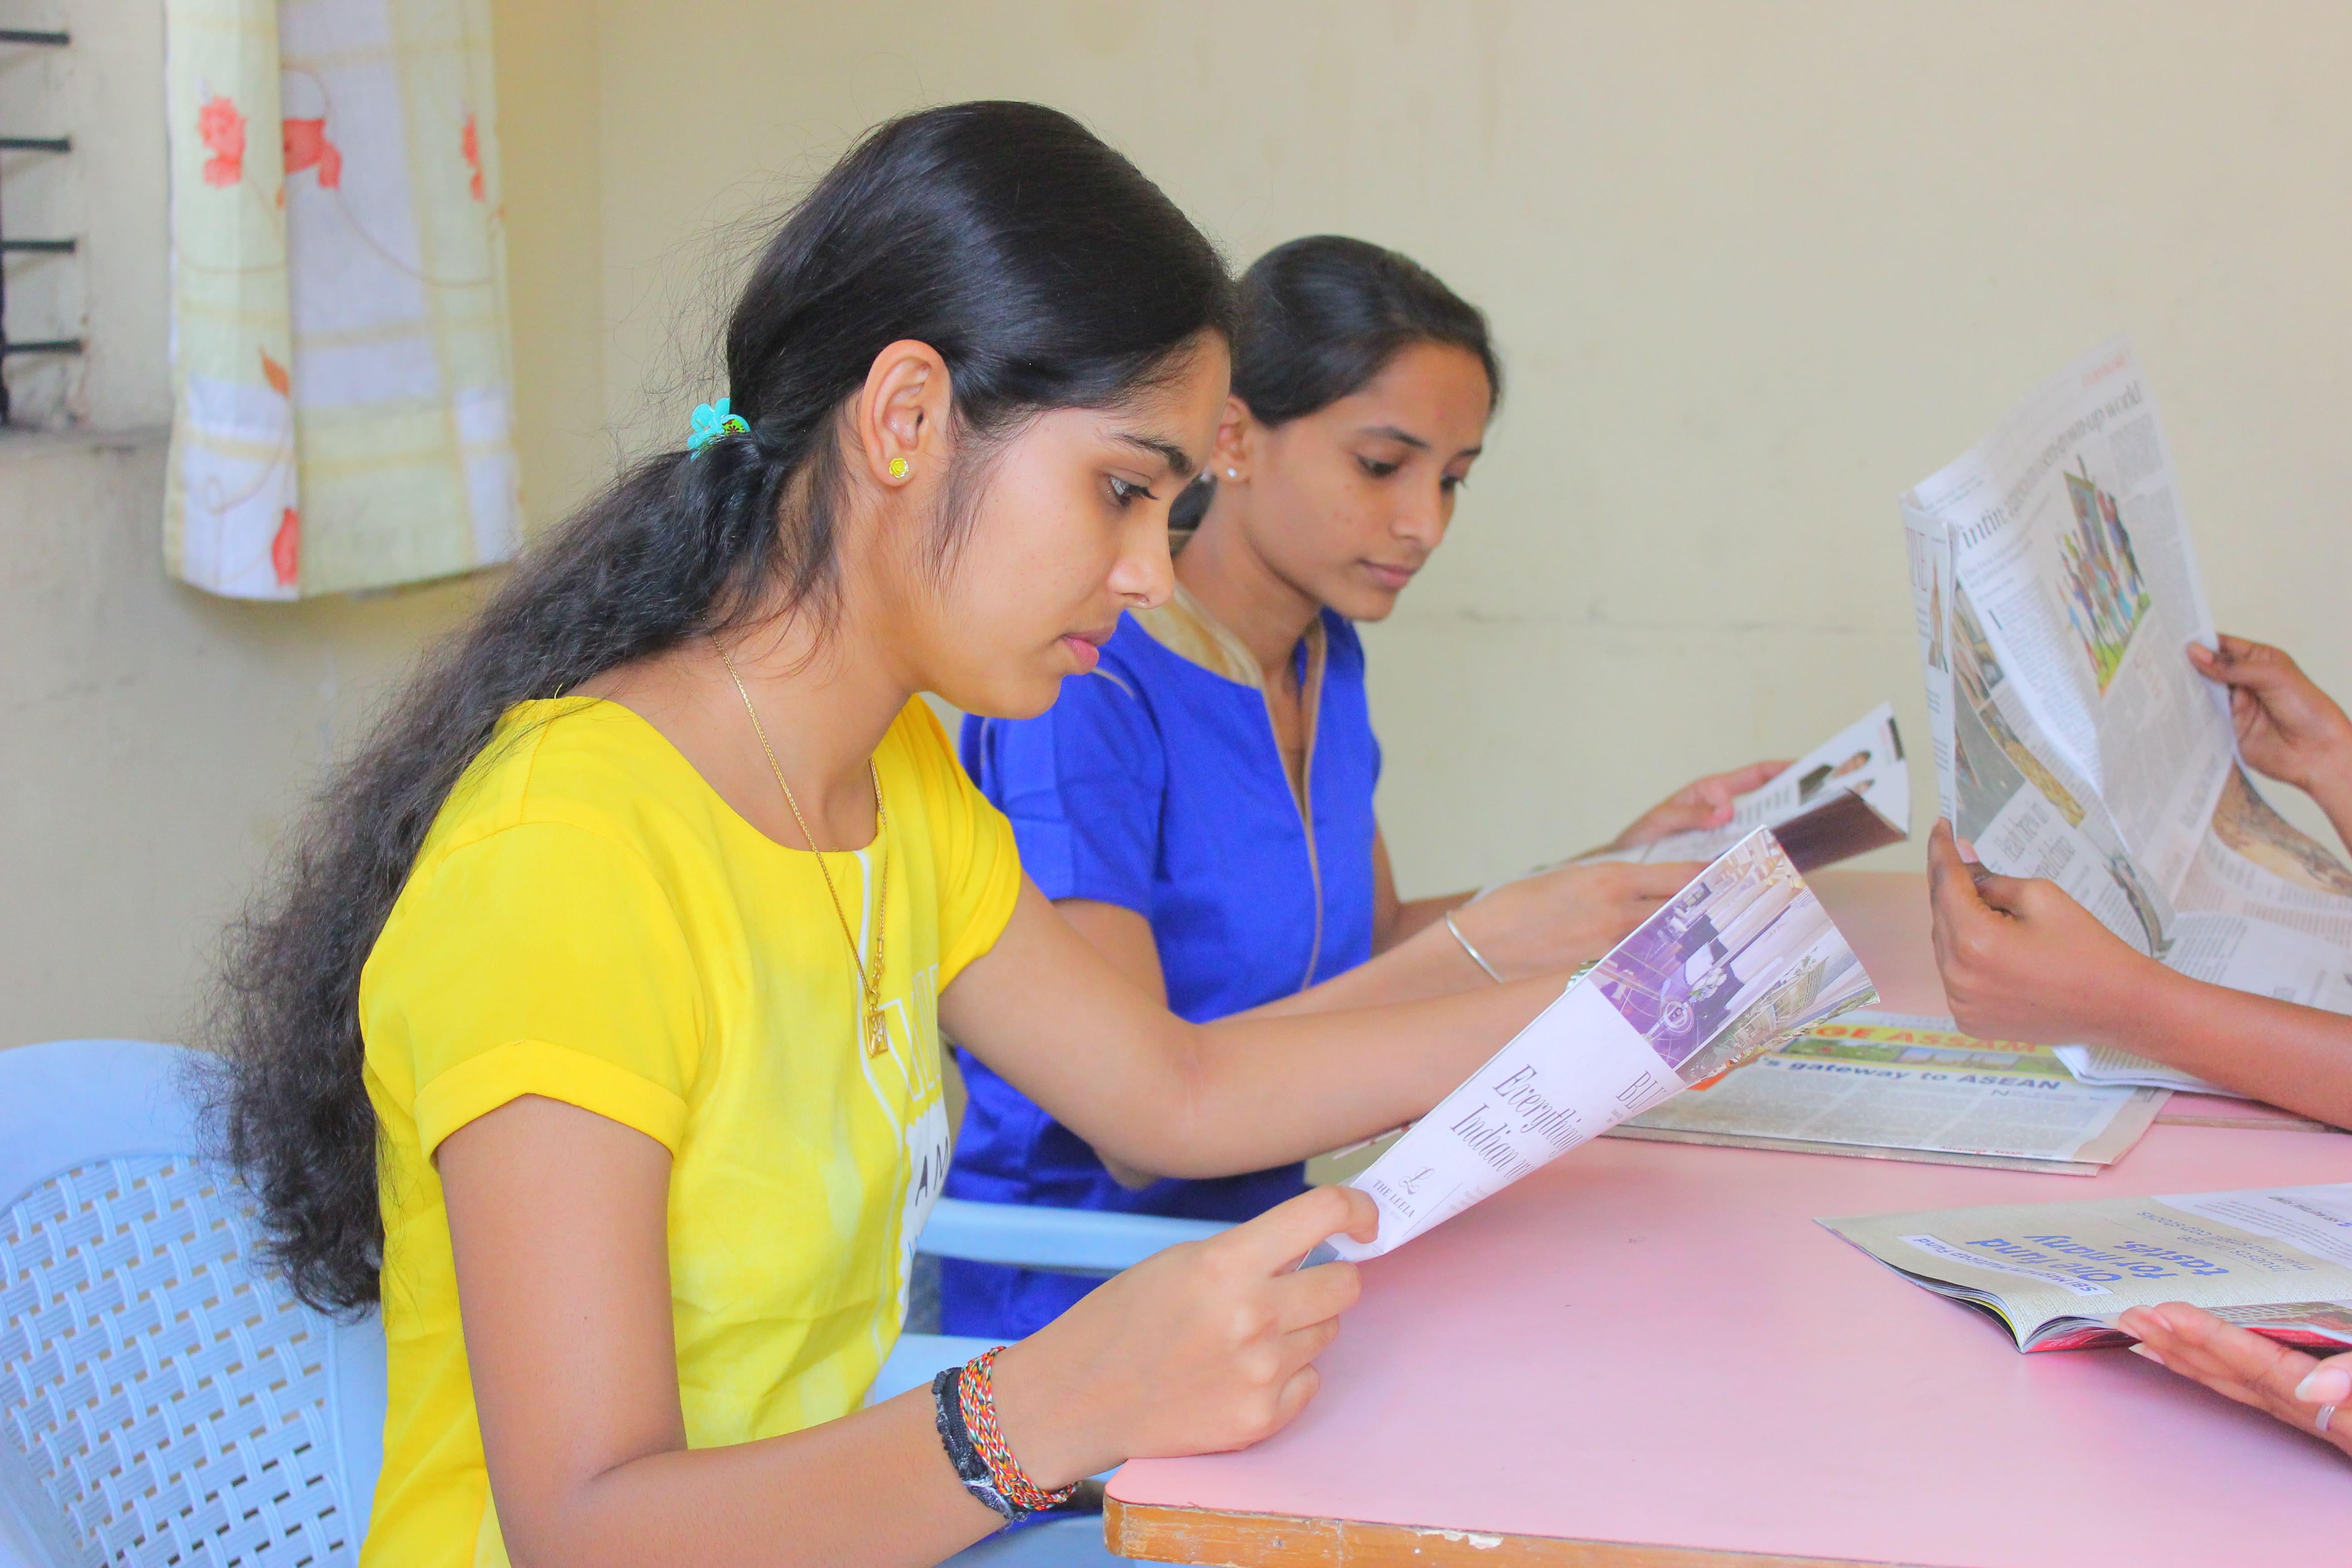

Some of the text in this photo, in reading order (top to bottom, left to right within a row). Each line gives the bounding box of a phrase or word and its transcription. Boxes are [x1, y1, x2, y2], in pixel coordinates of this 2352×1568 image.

[1885, 1031, 2036, 1053] ASSAM
[1788, 1063, 1911, 1079] gateway
[1921, 1072, 1948, 1081] to
[1956, 1074, 2061, 1090] ASEAN
[1492, 1063, 1584, 1158] Everything
[1449, 1102, 1519, 1172] Indian
[1372, 1179, 1392, 1197] THE
[1389, 1193, 1415, 1218] LEELA
[1912, 1237, 1950, 1254] Fund
[2023, 1235, 2179, 1279] for many
[2244, 1246, 2283, 1258] and
[1950, 1251, 2011, 1270] Multicap
[1965, 1238, 2122, 1282] One fund
[2113, 1240, 2230, 1276] tastes.
[2229, 1250, 2289, 1272] Invests
[2273, 1259, 2315, 1271] mid
[2067, 1280, 2098, 1292] SBI
